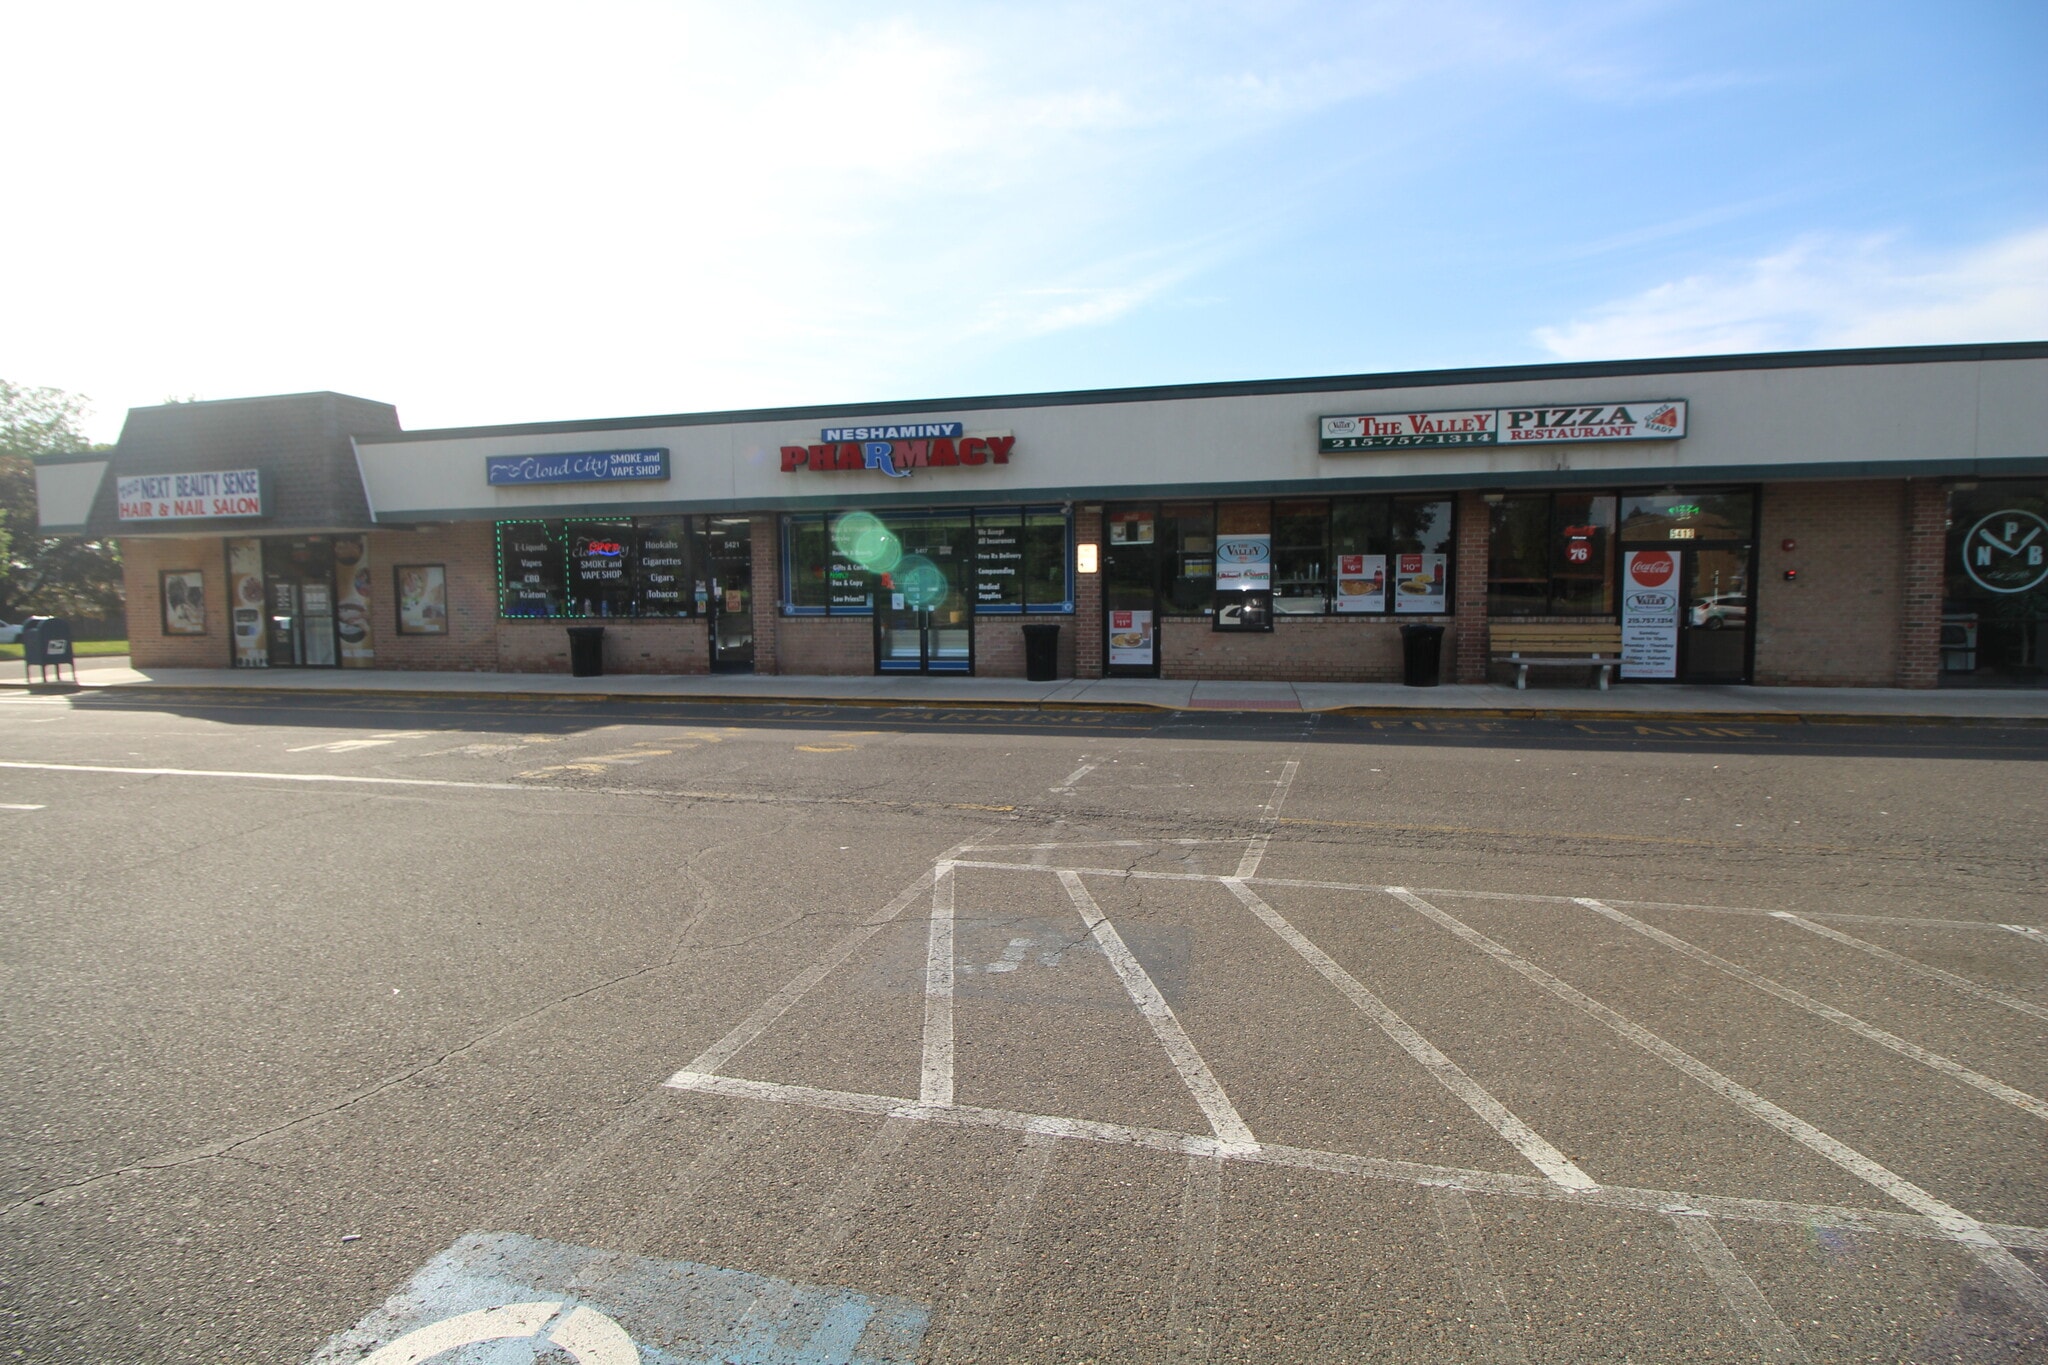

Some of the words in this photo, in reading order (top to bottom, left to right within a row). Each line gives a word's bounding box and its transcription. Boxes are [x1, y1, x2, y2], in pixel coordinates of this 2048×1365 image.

[1507, 406, 1638, 430] PIZZA
[1359, 415, 1403, 437] THE
[1408, 414, 1492, 434] VALLEY
[827, 424, 955, 441] NESHAMINY
[1511, 425, 1636, 441] RESTAURANT
[1332, 432, 1492, 449] 215-757-1314
[610, 453, 642, 465] SMOKE
[643, 452, 660, 463] and
[780, 436, 1016, 478] PHARMACY
[524, 459, 571, 480] Cloud
[574, 456, 608, 478] City
[611, 466, 635, 477] VAPE
[636, 465, 661, 476] SHOP
[140, 477, 170, 498] NEXT
[176, 474, 220, 497] BEAUTY
[223, 471, 257, 494] SENSE
[119, 501, 153, 518] HAIR
[159, 502, 169, 517] &
[174, 499, 206, 516] NAIL
[213, 497, 259, 515] SALON
[2005, 522, 2018, 541] P
[645, 541, 679, 550] Hookahs
[724, 541, 740, 549] 5421
[1227, 545, 1260, 555] VALLEY
[1570, 548, 1588, 560] 76
[1977, 546, 1992, 566] N
[2028, 546, 2043, 565] B
[521, 559, 542, 568] Vapes
[580, 560, 607, 569] SMOKE
[608, 559, 622, 568] and
[643, 557, 682, 567] Cigarettes
[581, 571, 601, 580] VAPE
[602, 570, 623, 579] SHOP
[650, 573, 675, 582] Cigars
[978, 567, 1016, 576] Compounding
[524, 574, 540, 583] CBD
[519, 589, 547, 599] Kratom
[648, 589, 679, 599] Tobacco
[1636, 595, 1668, 605] VALLEY
